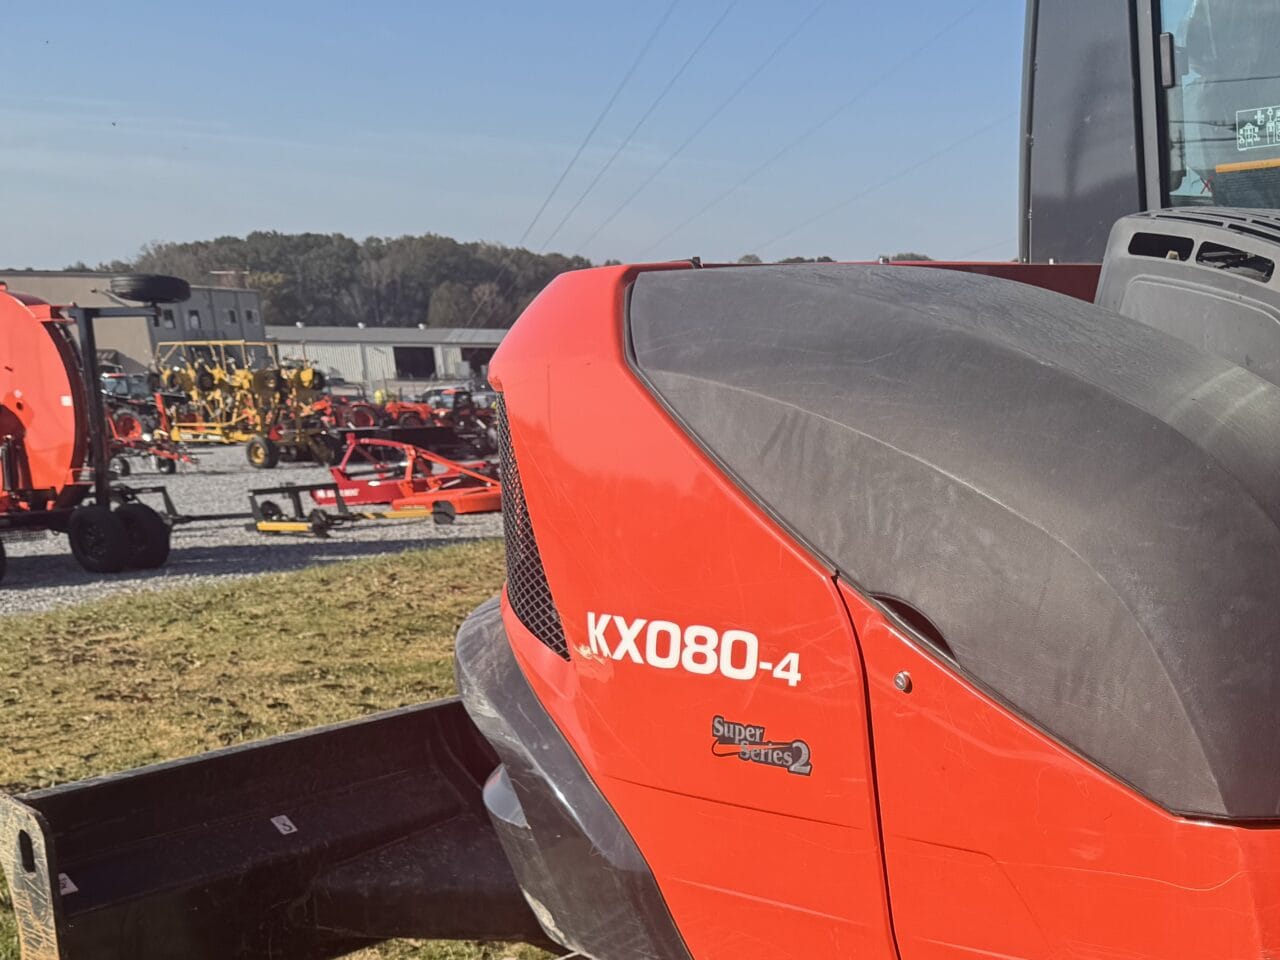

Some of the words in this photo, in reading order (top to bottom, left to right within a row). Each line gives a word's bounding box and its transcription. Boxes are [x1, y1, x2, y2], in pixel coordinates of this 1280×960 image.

[587, 611, 801, 687] KX080-4
[713, 716, 764, 744] Super
[740, 740, 793, 766] Series
